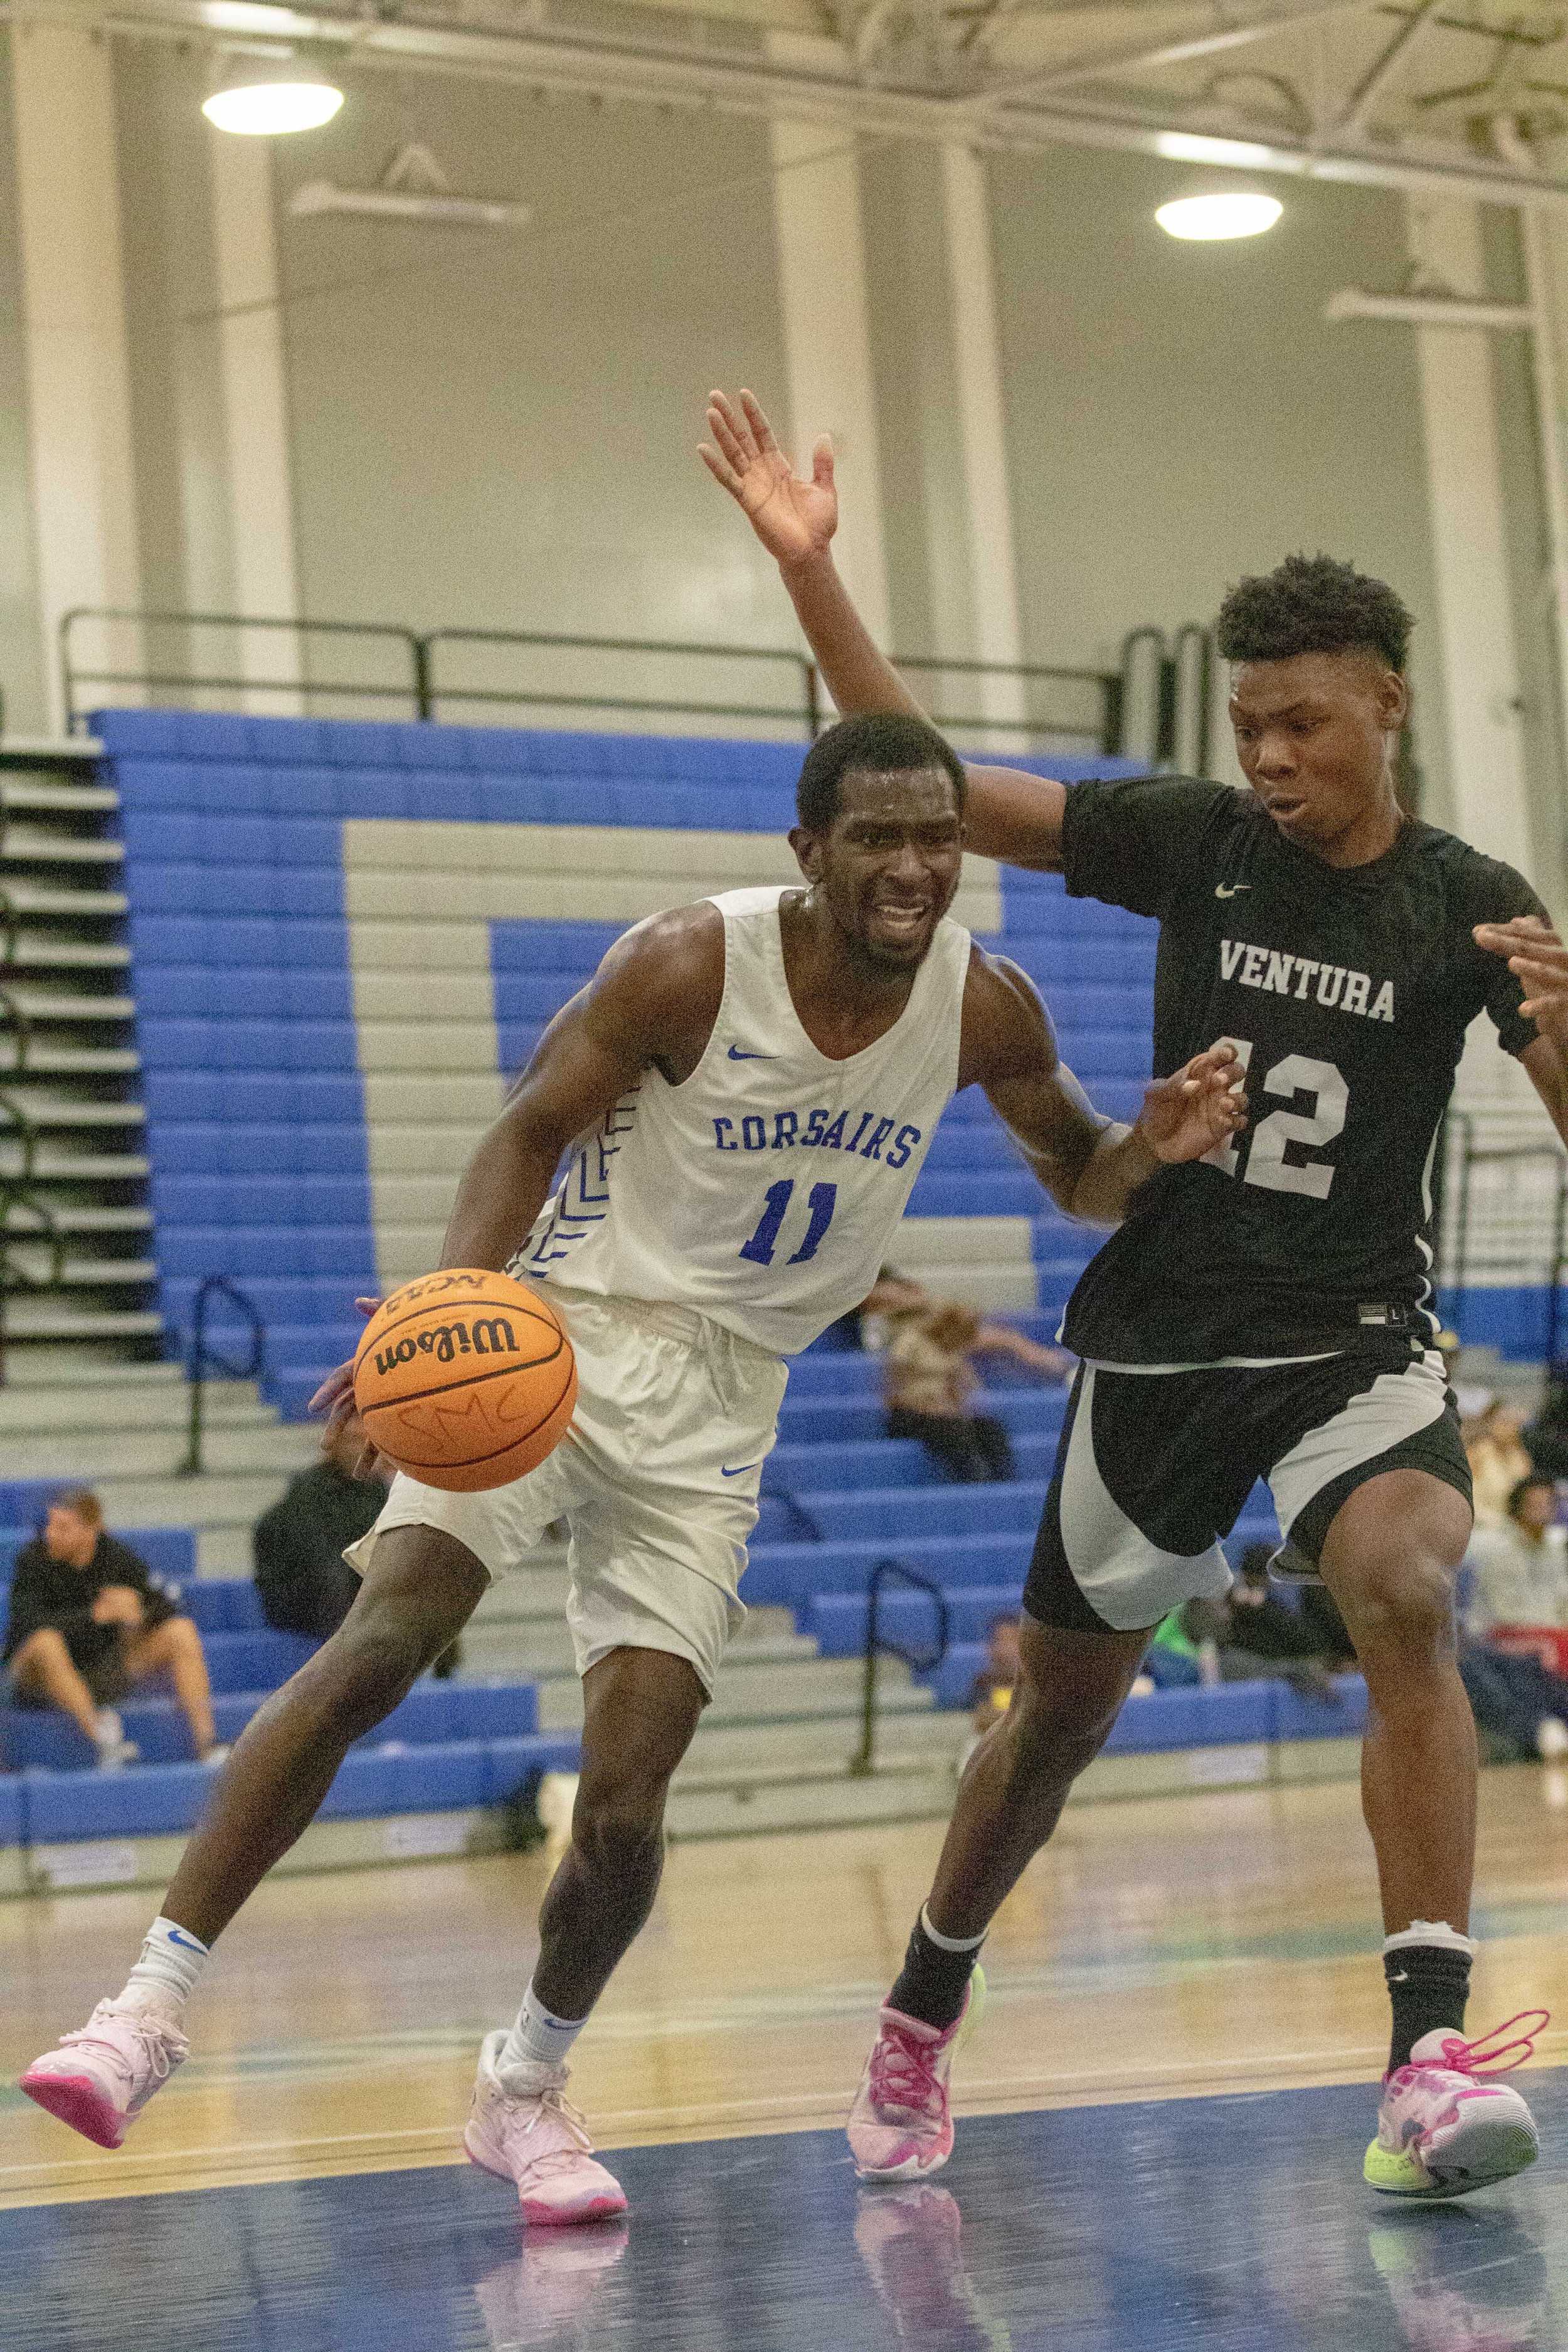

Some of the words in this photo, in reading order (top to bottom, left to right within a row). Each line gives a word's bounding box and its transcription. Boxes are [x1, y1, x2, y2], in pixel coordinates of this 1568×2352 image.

[1220, 940, 1395, 1022] VENTURA
[712, 1109, 922, 1169] CORSAIRS
[738, 1179, 837, 1266] 11
[374, 1317, 521, 1376] Wilson
